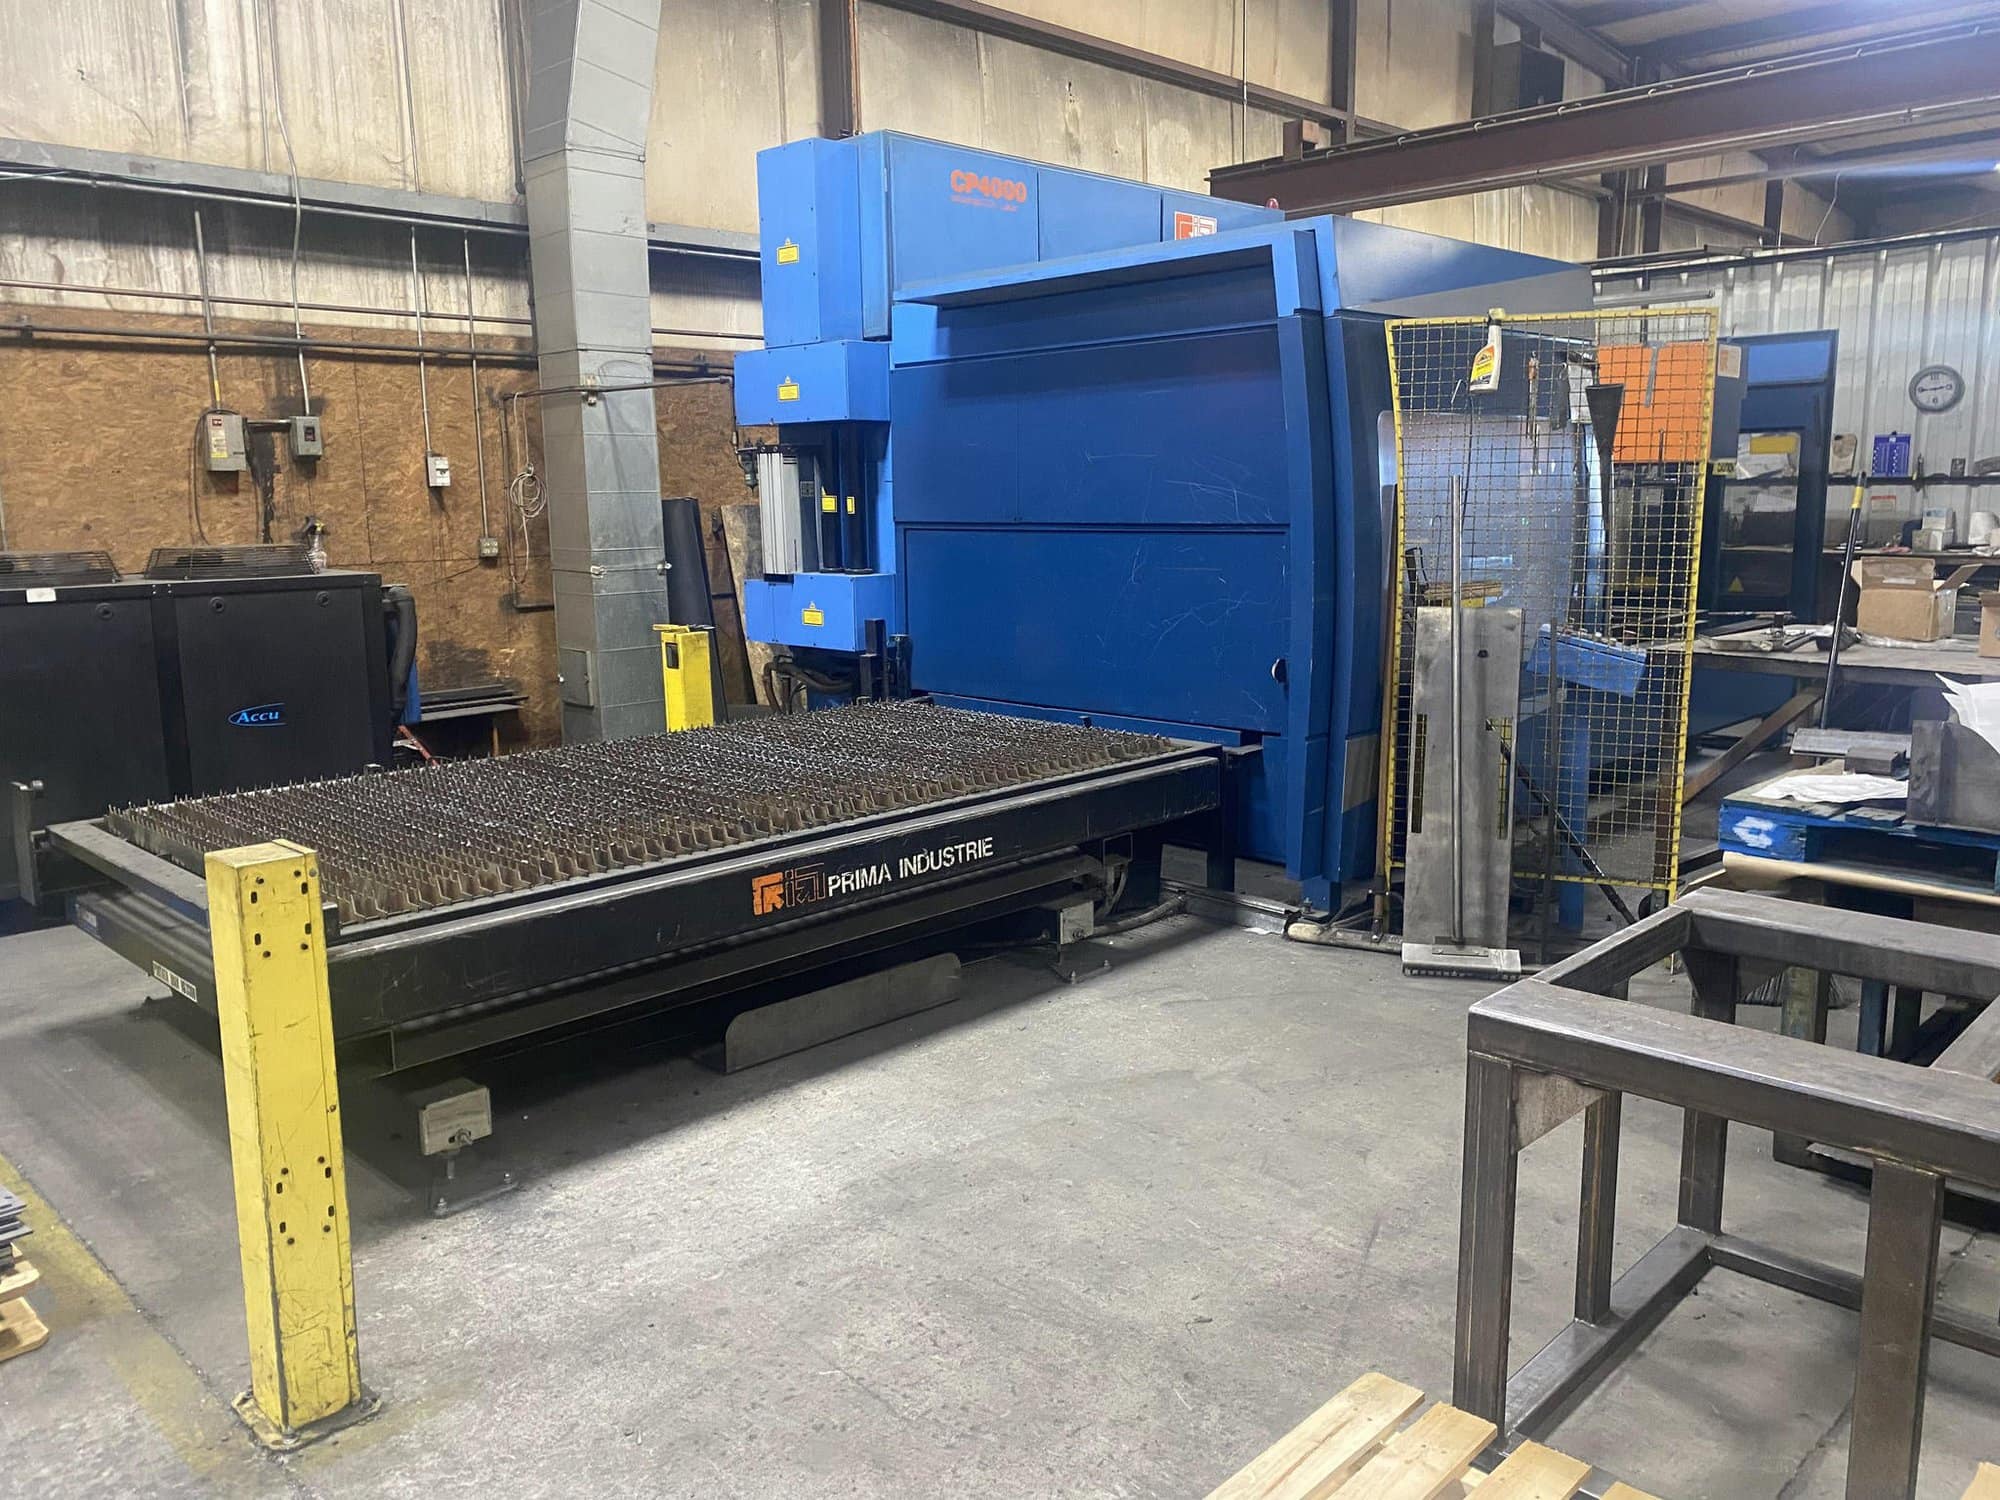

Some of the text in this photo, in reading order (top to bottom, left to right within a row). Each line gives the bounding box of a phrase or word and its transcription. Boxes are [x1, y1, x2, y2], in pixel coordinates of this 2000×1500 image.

[950, 169, 1028, 204] CP4000
[236, 711, 280, 724] Accu
[828, 837, 994, 897] PRIMA INDUSTRIE
